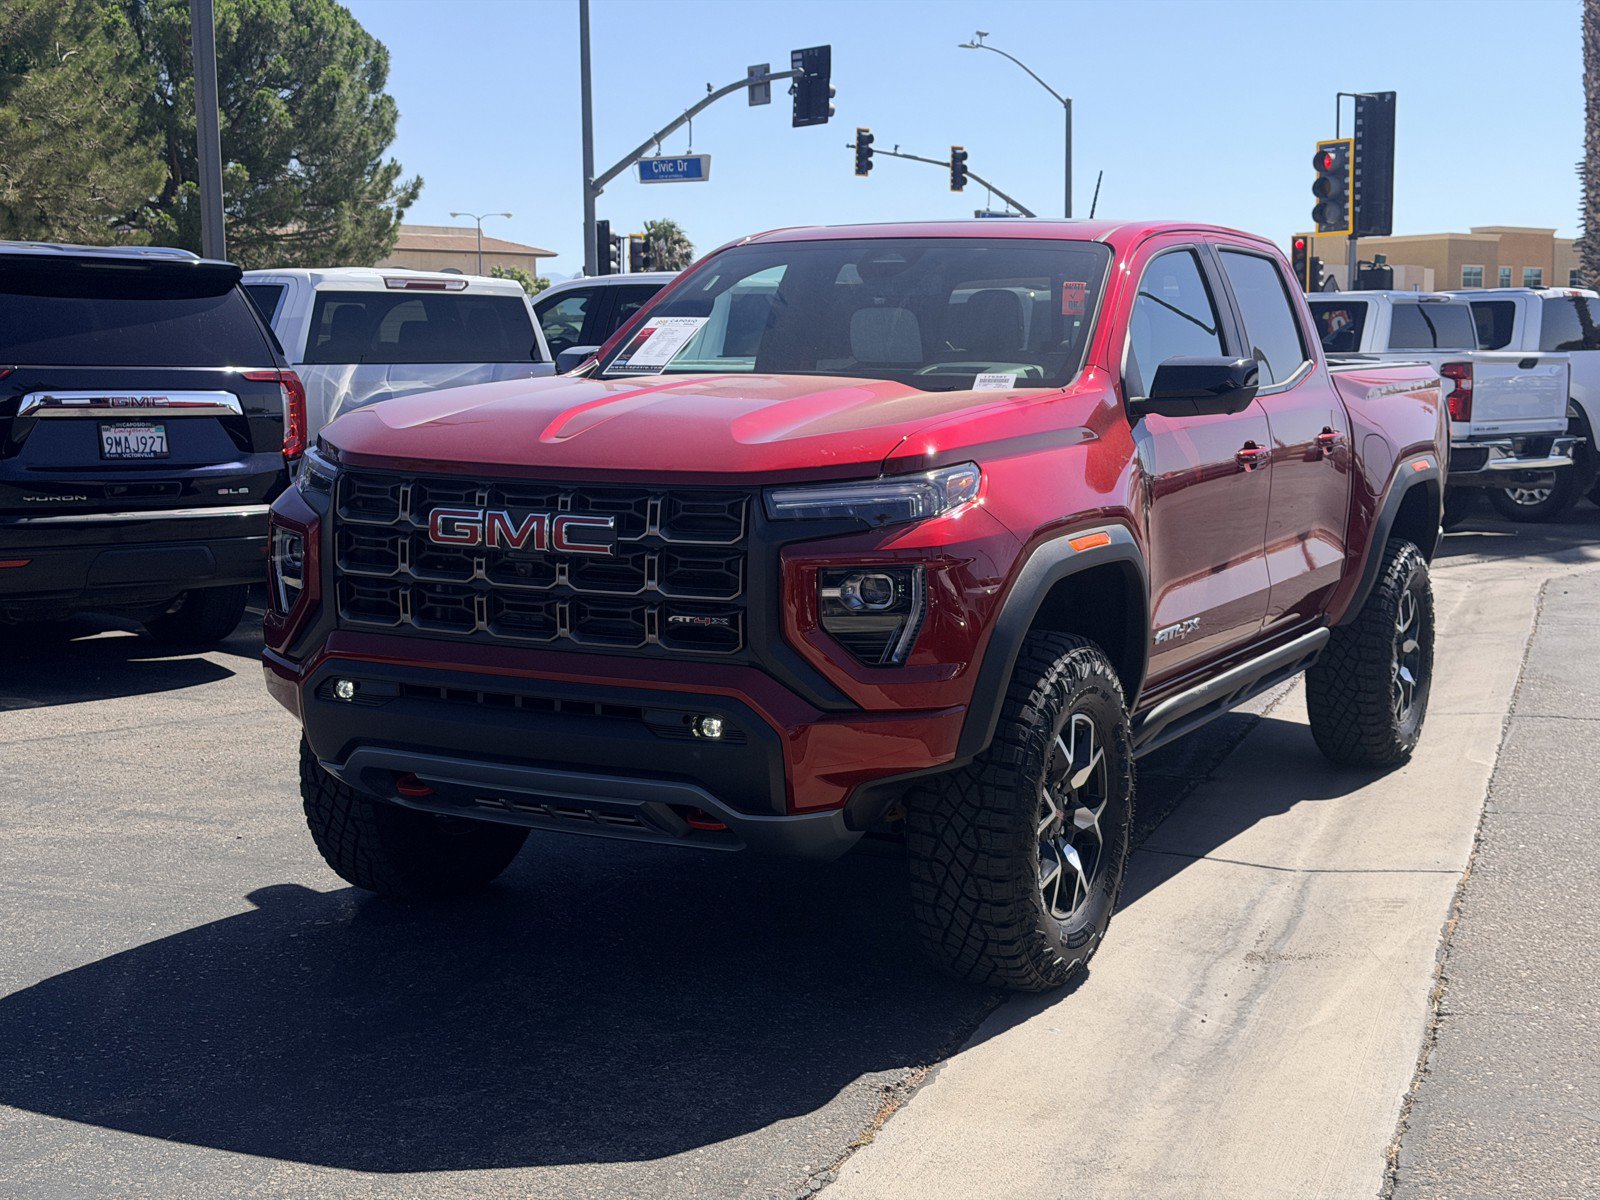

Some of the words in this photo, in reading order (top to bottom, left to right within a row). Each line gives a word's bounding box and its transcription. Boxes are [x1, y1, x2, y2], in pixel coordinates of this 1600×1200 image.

[652, 161, 674, 173] Civic
[677, 160, 688, 171] Dr
[109, 396, 170, 408] GMC
[105, 435, 164, 454] 9MAJ927
[428, 507, 616, 557] GMC
[667, 614, 730, 627] AT4X
[1154, 617, 1200, 646] AT4X
